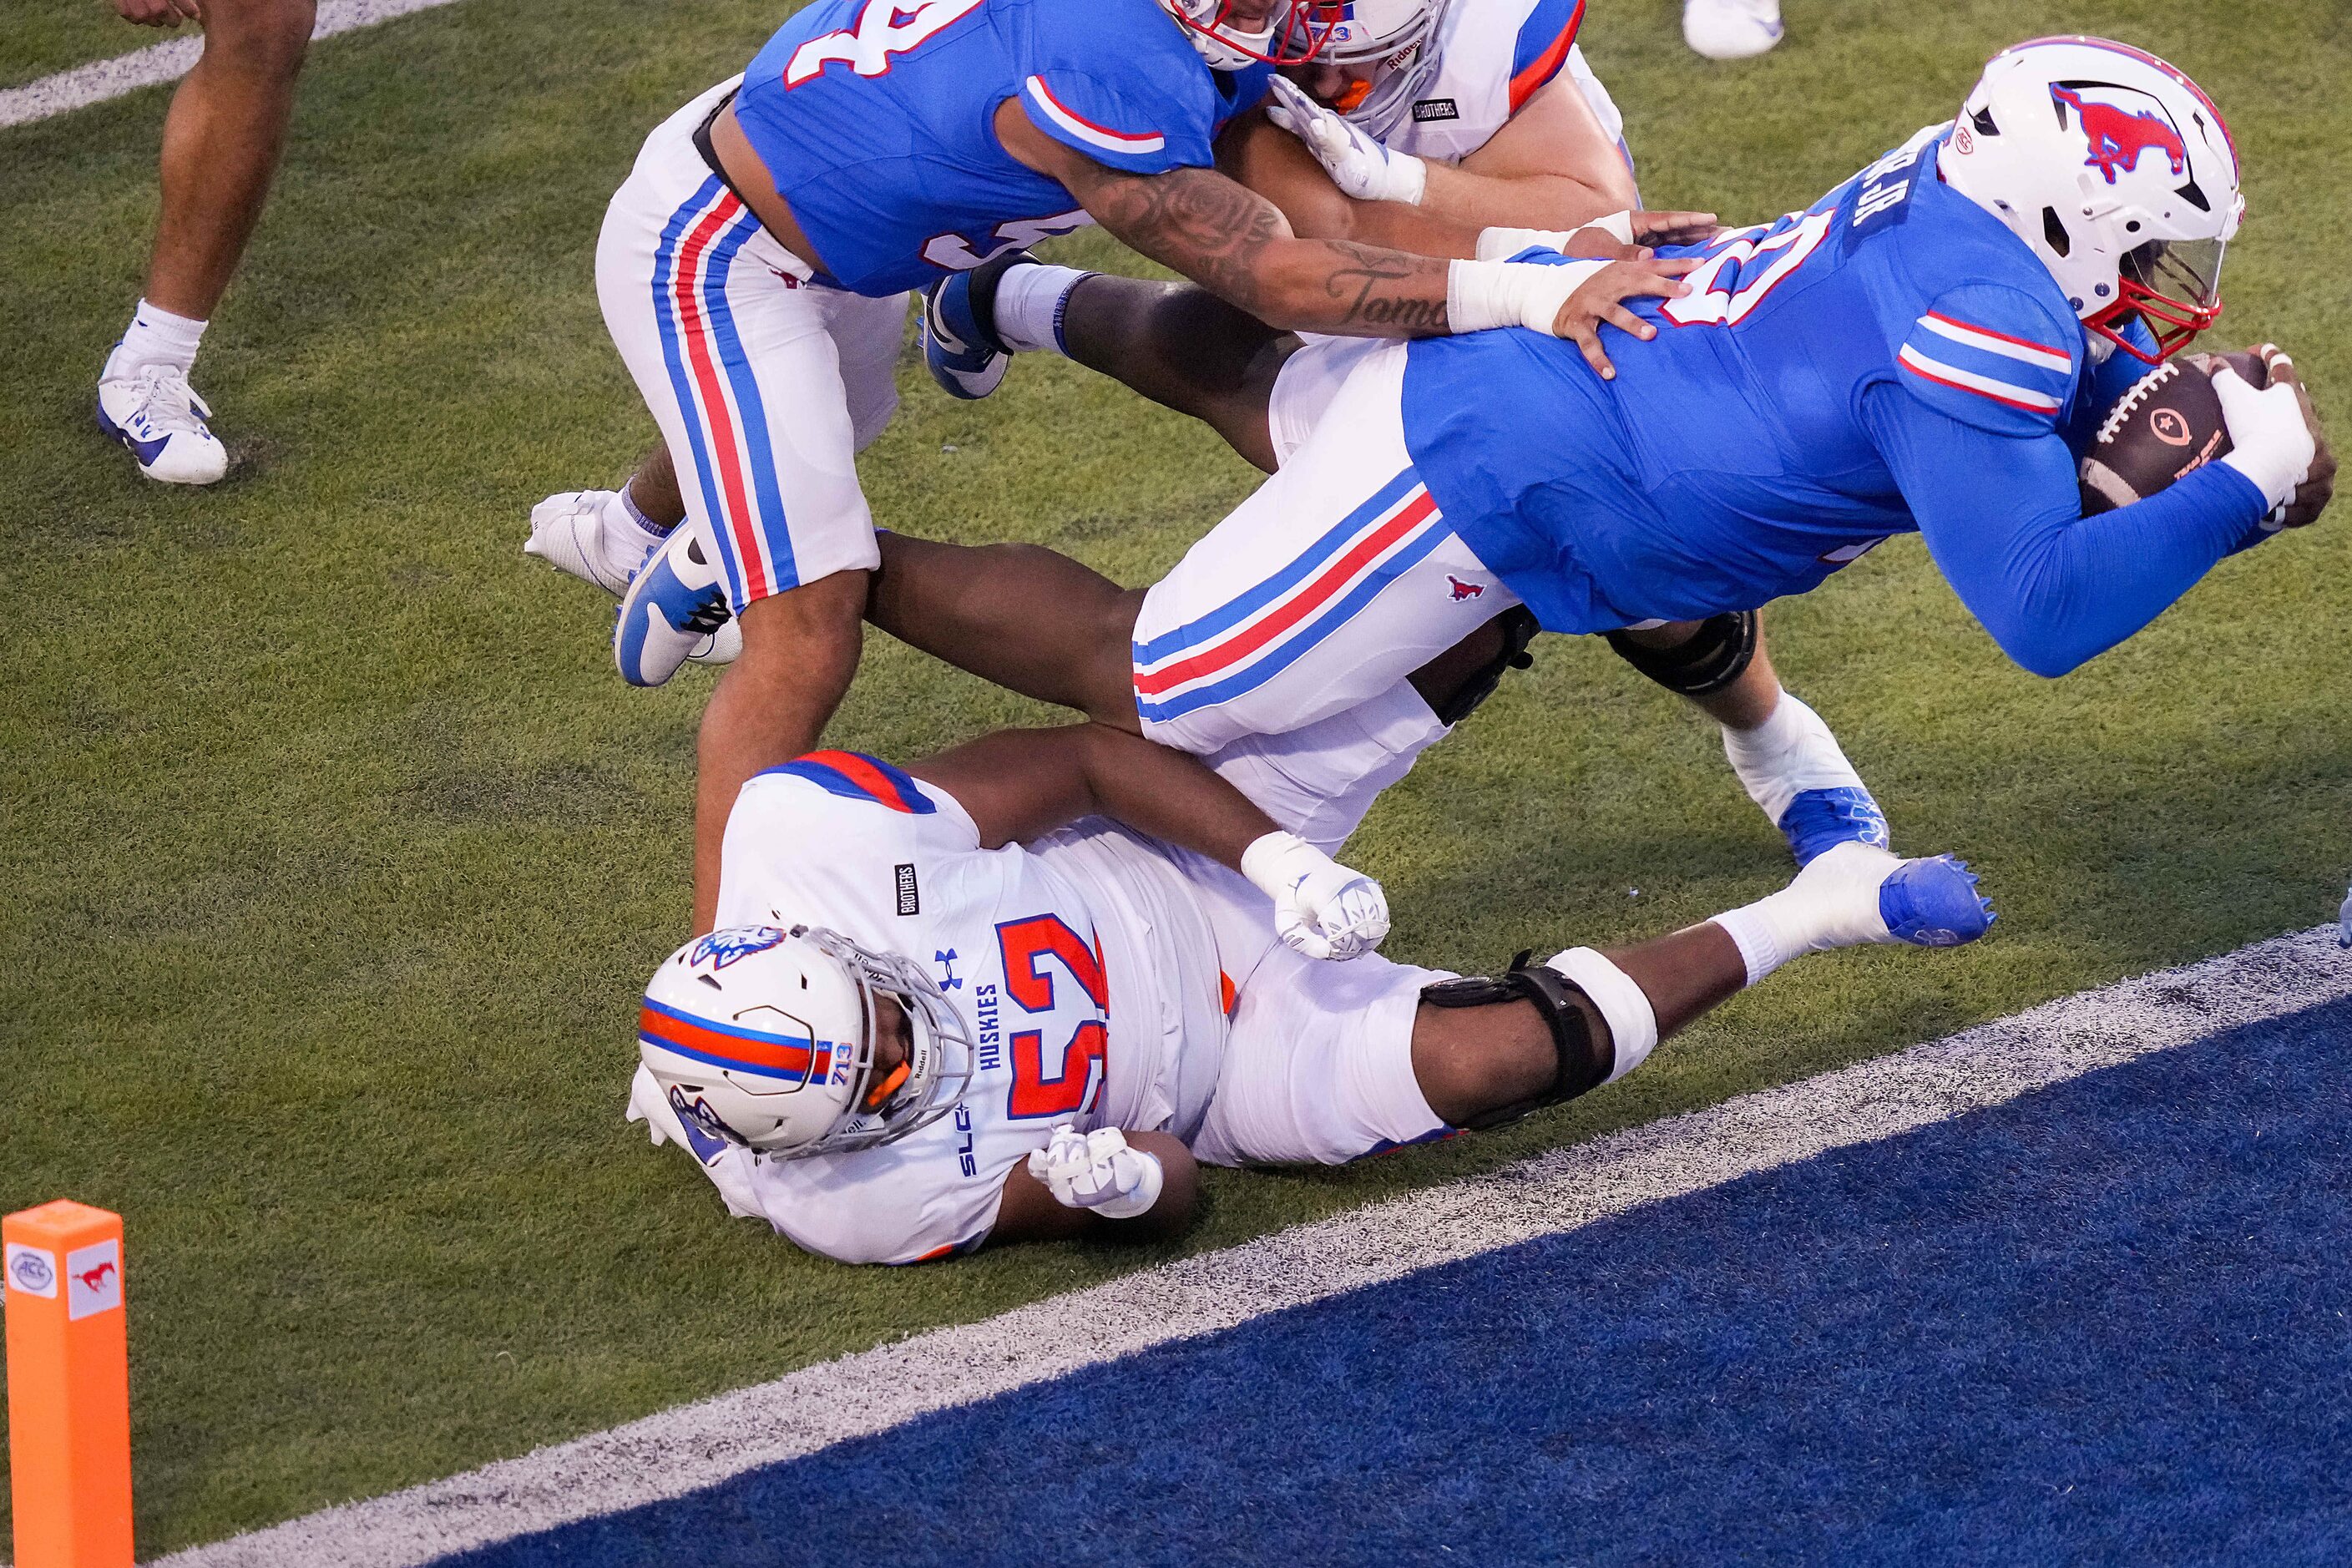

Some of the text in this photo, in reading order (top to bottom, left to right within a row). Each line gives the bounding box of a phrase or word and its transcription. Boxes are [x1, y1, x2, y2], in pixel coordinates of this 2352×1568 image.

[1414, 102, 1456, 119] BROTHERS
[898, 867, 917, 913] BROTHERS
[976, 984, 1001, 1071] HUSKIES
[995, 913, 1110, 1120] 52
[831, 1042, 854, 1086] 713
[914, 1050, 928, 1080] Riddell
[954, 1101, 977, 1178] SLC
